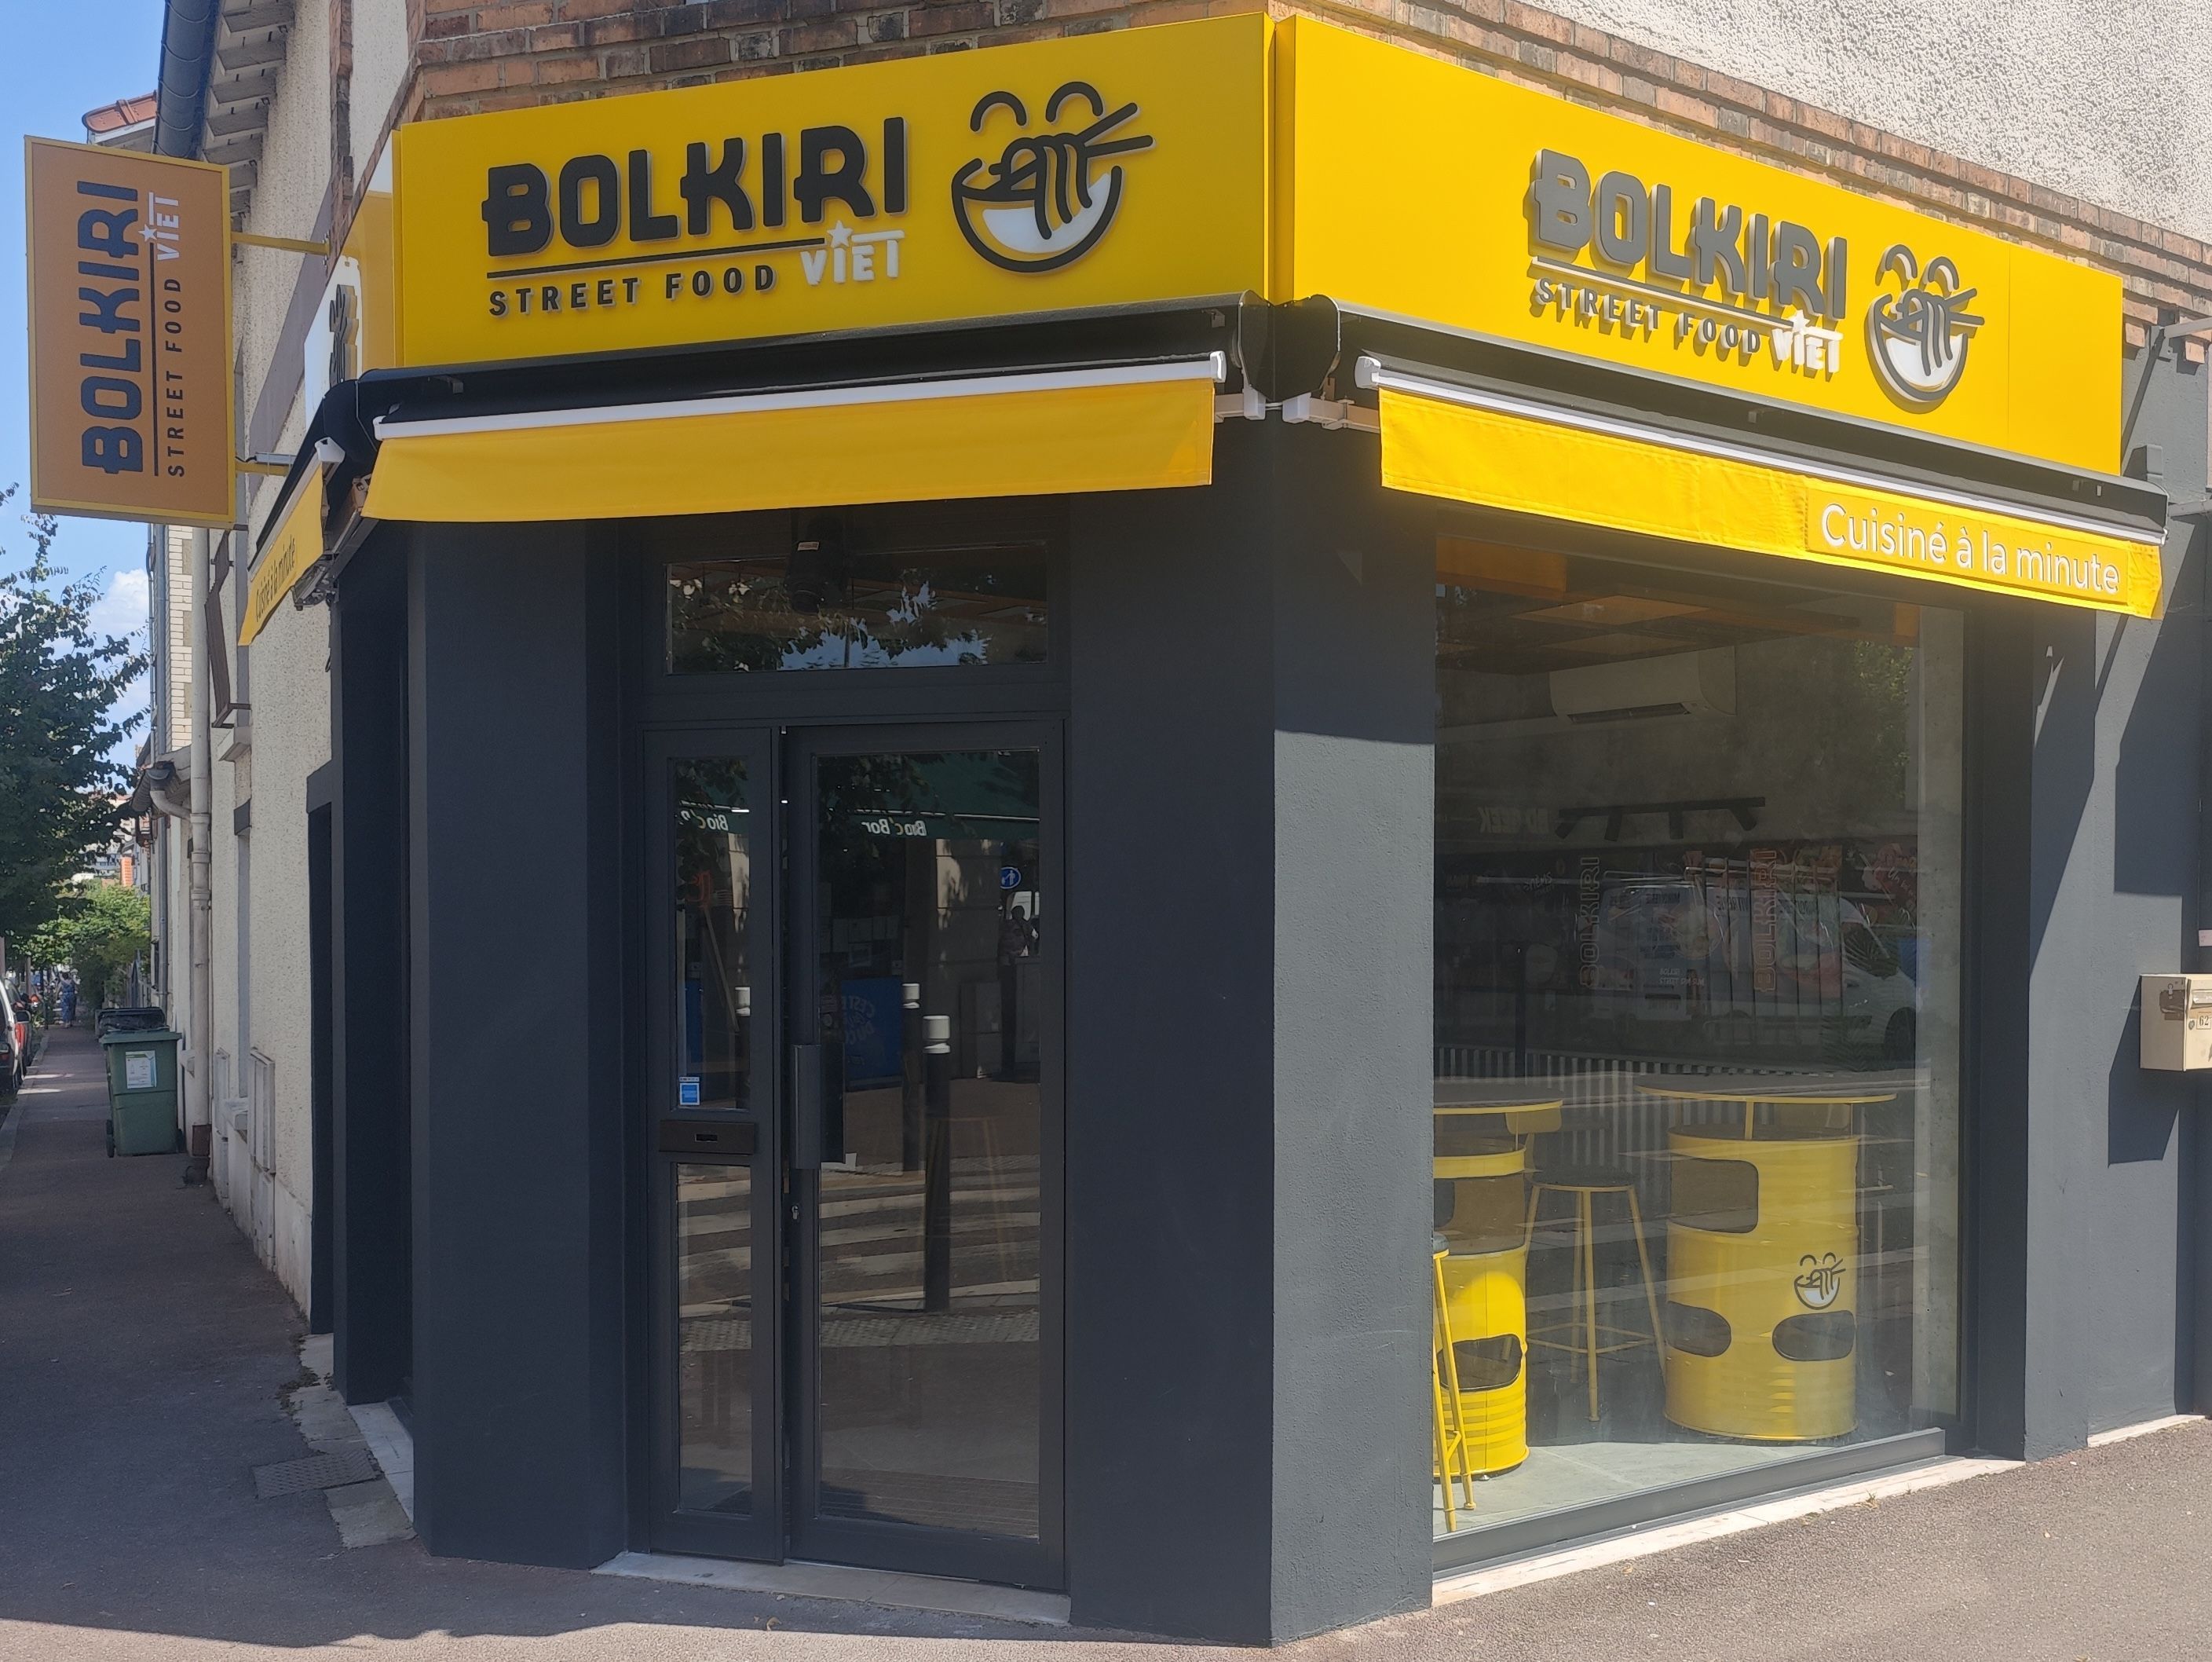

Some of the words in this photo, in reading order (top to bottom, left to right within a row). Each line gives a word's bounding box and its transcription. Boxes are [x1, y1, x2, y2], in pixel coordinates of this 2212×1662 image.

[138, 192, 179, 261] VIET
[481, 116, 908, 258] BOLKIRI
[800, 220, 905, 285] VIET
[1534, 148, 1847, 320] BOLKIRI
[77, 181, 143, 474] BOLKIRI
[165, 278, 182, 352] FOOD
[488, 277, 642, 317] STREET
[665, 265, 777, 300] FOOD
[1535, 278, 1662, 331] STREET
[1679, 312, 1760, 353] FOOD
[1771, 310, 1844, 373] VIET
[166, 371, 185, 478] STREET
[1822, 503, 1948, 566] Cuisiné
[1956, 527, 1973, 569] à
[1983, 530, 2007, 575] la
[2016, 542, 2120, 595] minute
[1580, 857, 1600, 987] BOLKIRI
[1753, 851, 1777, 992] BOLKIRI
[2199, 1015, 2209, 1027] 62
